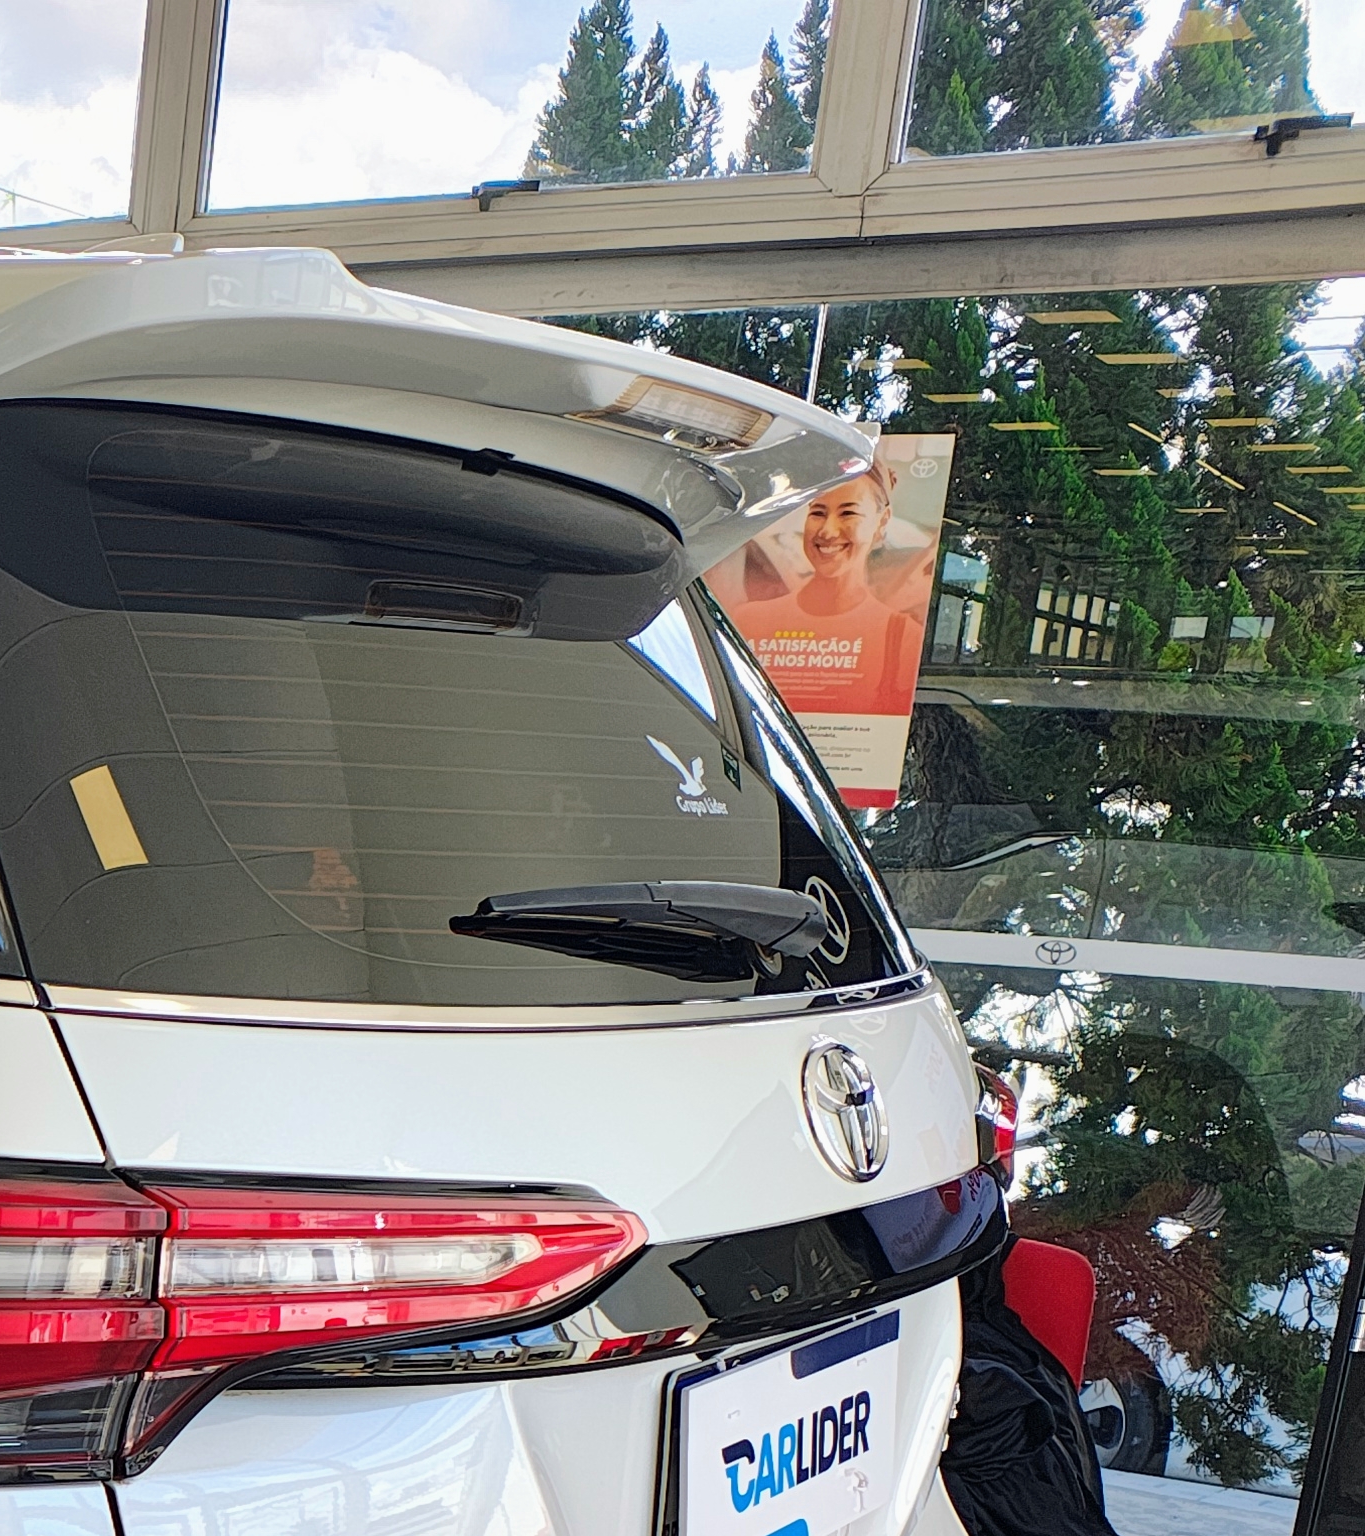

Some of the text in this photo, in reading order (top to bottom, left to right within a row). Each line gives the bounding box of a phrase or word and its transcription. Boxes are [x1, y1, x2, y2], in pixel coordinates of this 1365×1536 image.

[758, 637, 851, 656] SATISFAÇÃO
[853, 637, 863, 654] É
[773, 654, 806, 667] NOS
[807, 655, 858, 669] MOVE!
[721, 1390, 871, 1513] CARLIDER
